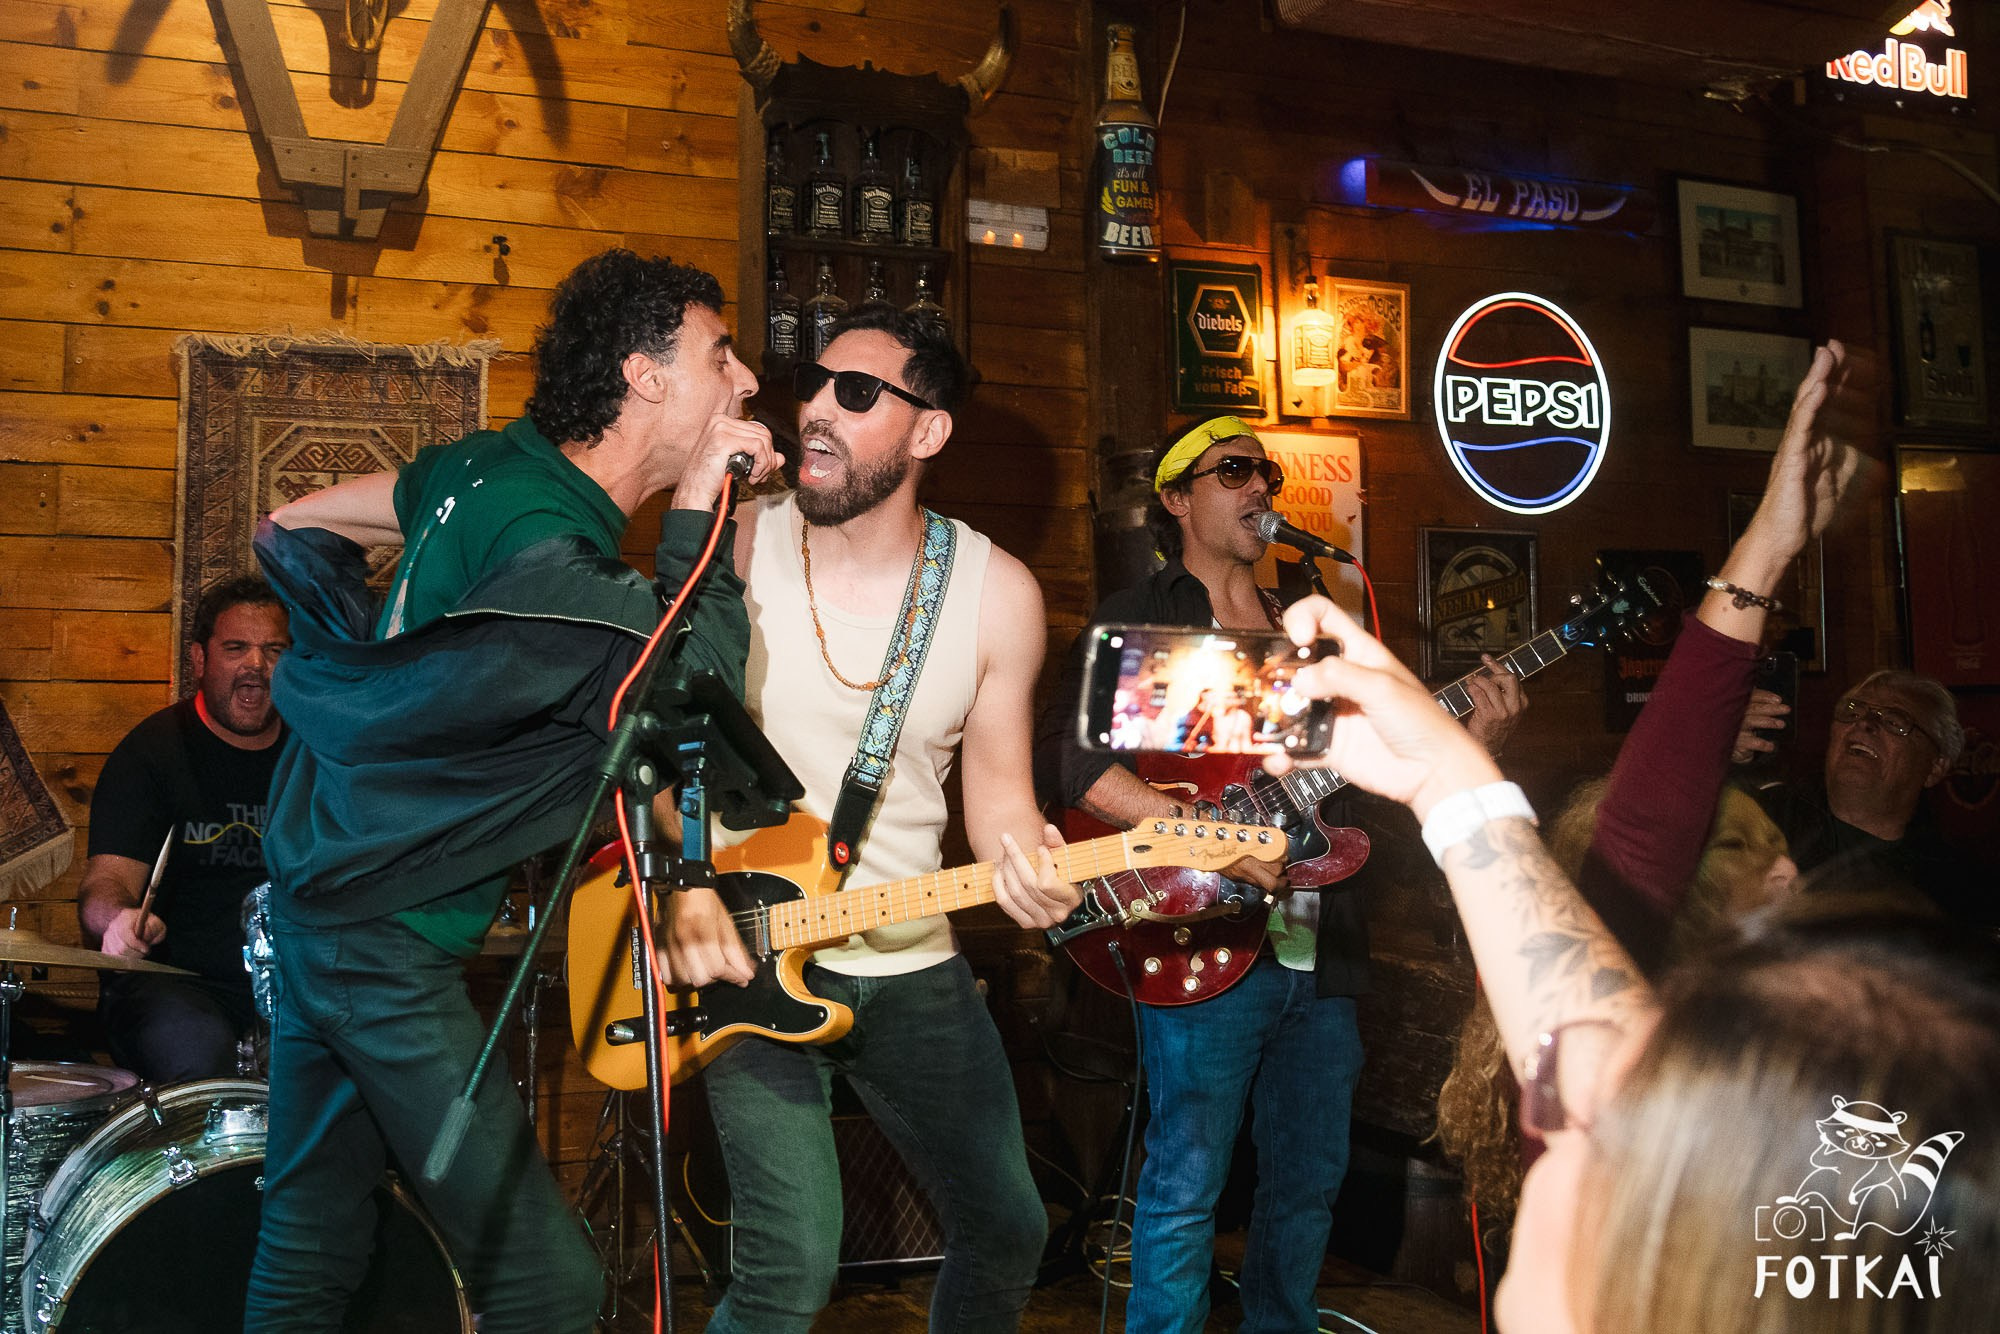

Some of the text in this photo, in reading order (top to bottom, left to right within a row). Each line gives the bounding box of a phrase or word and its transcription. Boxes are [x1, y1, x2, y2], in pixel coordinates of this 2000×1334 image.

[1900, 43, 1968, 99] Bull
[1103, 127, 1156, 151] COLD
[1112, 148, 1152, 165] BEER
[1132, 165, 1146, 178] all
[1113, 179, 1149, 193] FUN &
[1116, 195, 1154, 210] GAMES
[1460, 172, 1581, 222] EL PASO
[1103, 221, 1154, 247] BEER
[1201, 364, 1243, 379] Frisch
[1195, 382, 1221, 393] vom
[1446, 375, 1600, 429] PEPSI
[1283, 485, 1333, 506] GOOD
[1296, 511, 1333, 532] YOU
[184, 821, 264, 846] NORT
